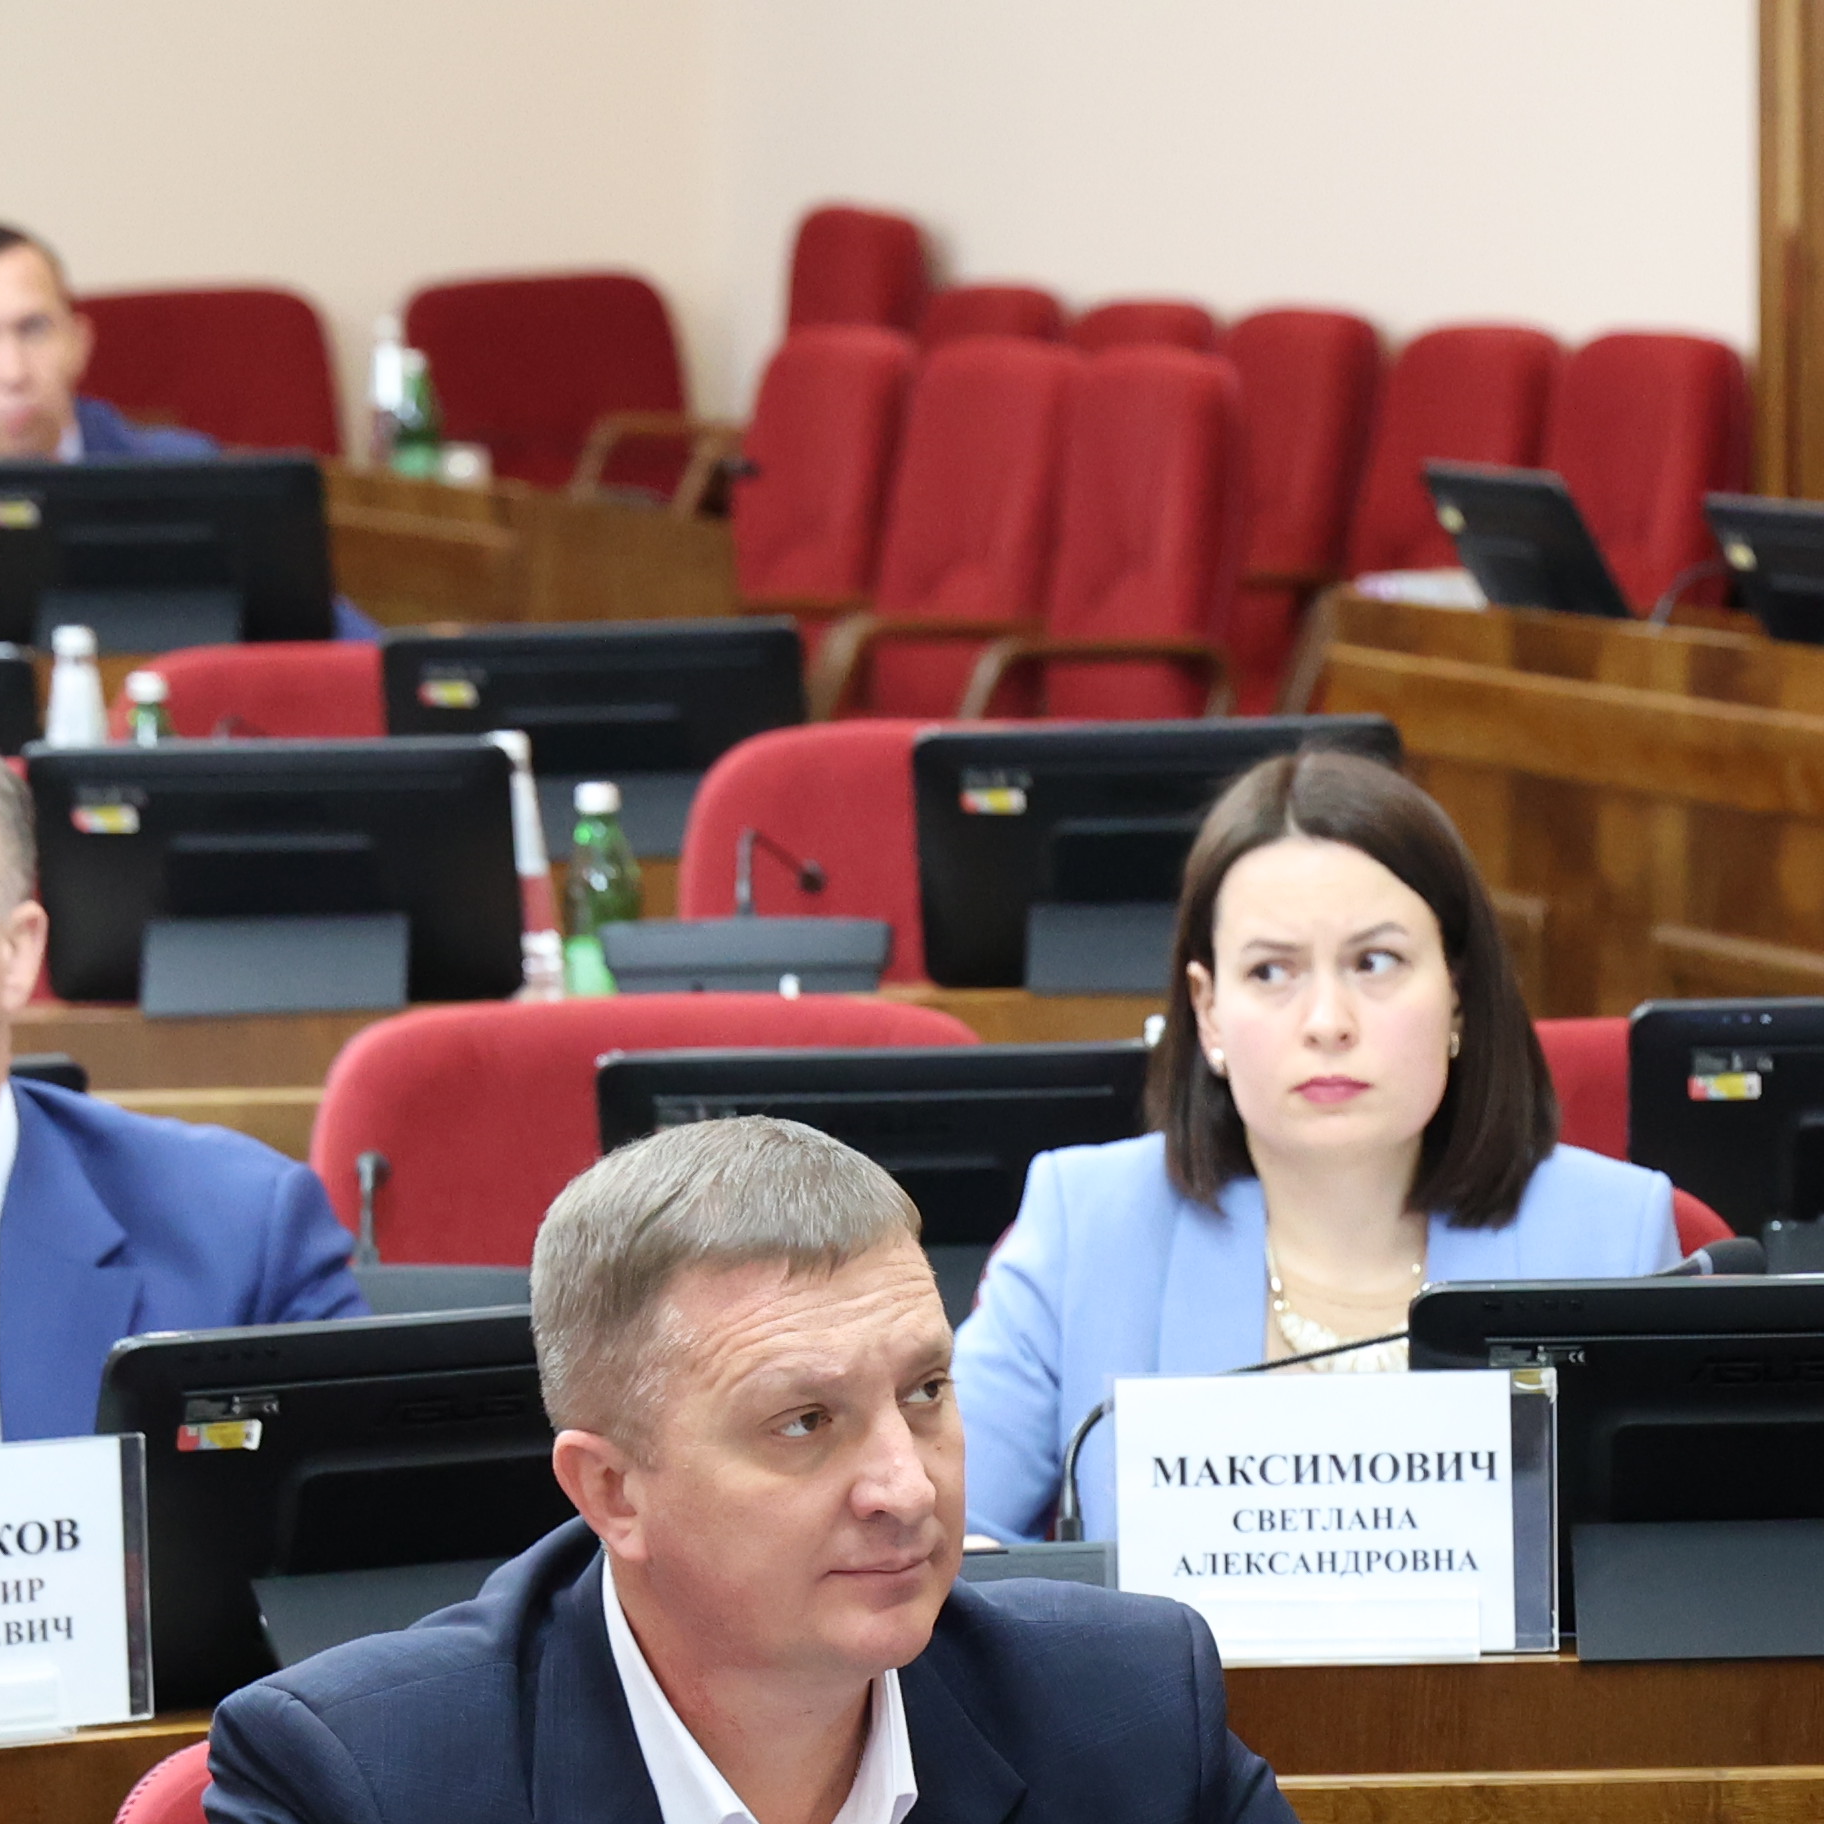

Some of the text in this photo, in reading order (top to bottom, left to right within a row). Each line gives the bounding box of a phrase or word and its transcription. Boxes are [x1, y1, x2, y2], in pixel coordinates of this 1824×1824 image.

[1152, 1450, 1499, 1487] МАКСИМОВИЧ
[1232, 1506, 1419, 1533] СВЕТЛАНА
[1174, 1548, 1480, 1578] АЛЕКСАНДРОВНА
